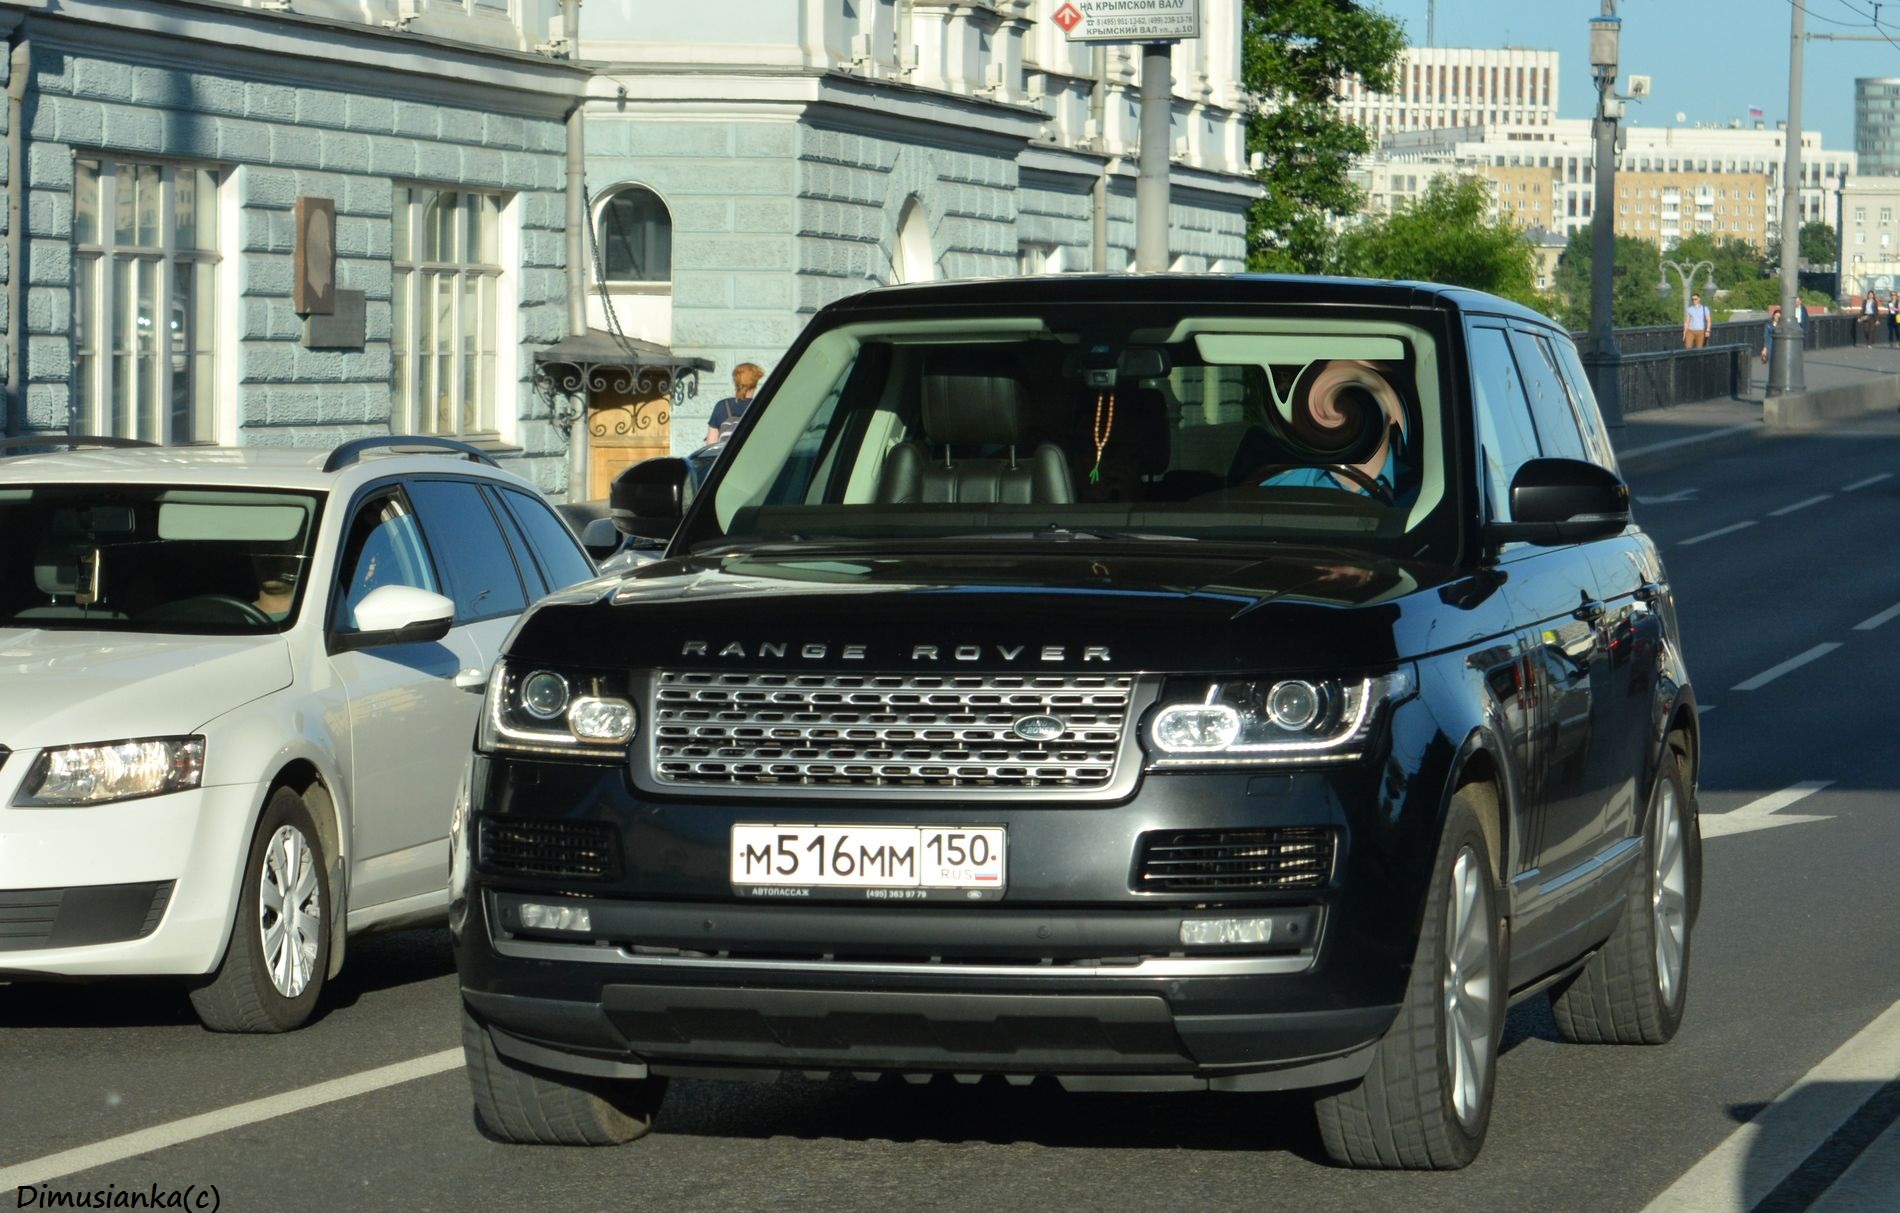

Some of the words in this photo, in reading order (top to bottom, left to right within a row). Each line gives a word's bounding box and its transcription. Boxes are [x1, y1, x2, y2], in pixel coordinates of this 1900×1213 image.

[1080, 2, 1093, 10] НА
[1096, 0, 1155, 10] КРЫМСКОМ
[1158, 0, 1184, 8] ВАЛУ
[1086, 27, 1137, 35] КРЫМСКИЙ
[681, 640, 867, 660] RANGE
[912, 644, 1112, 662] ROVER
[926, 834, 989, 866] 150
[941, 869, 972, 880] RUS
